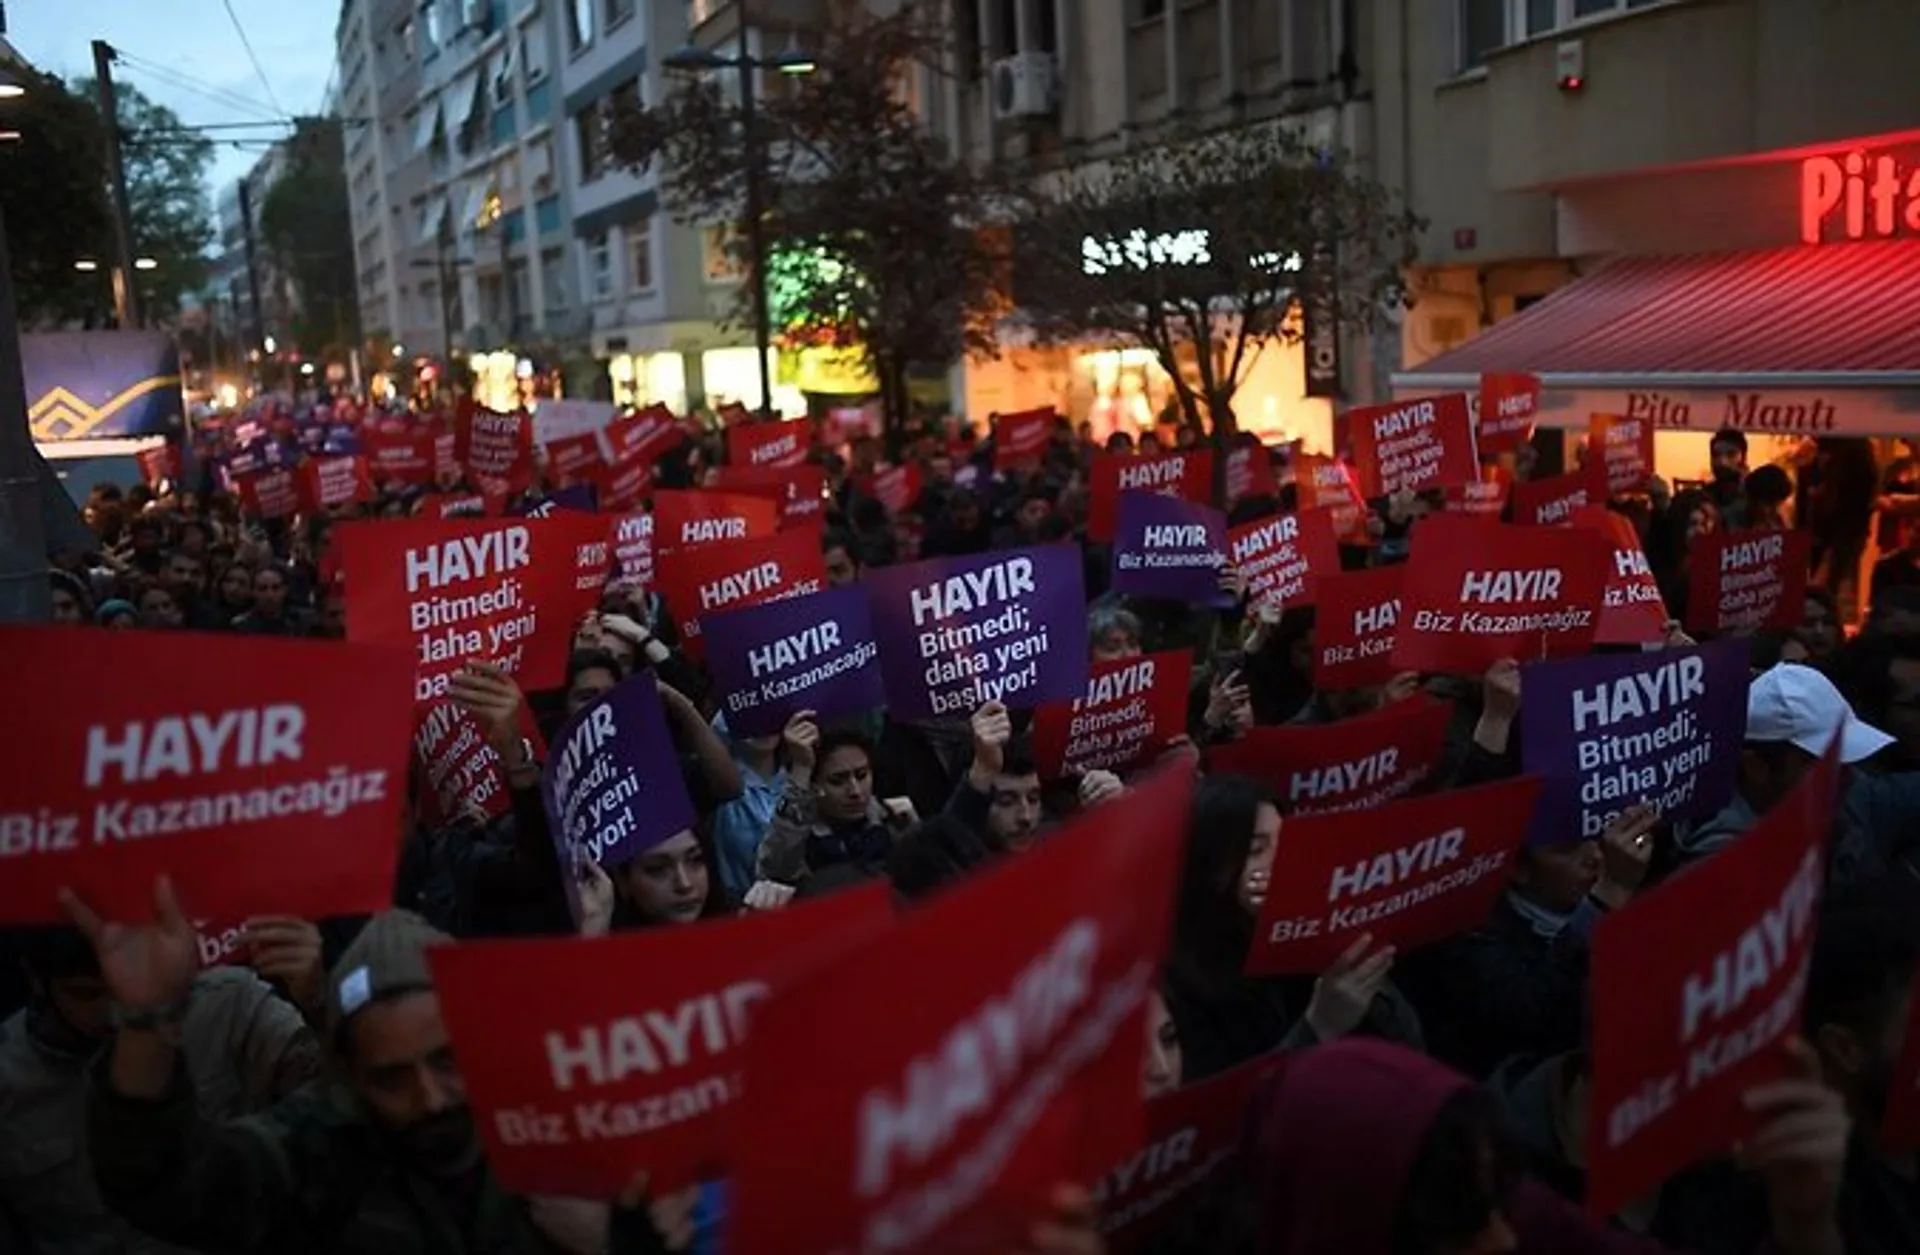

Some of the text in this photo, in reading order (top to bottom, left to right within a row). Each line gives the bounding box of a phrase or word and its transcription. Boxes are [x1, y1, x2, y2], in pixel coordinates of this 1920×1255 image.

[1374, 401, 1436, 440] HAYIR
[1723, 393, 1838, 430] Mantı
[1119, 457, 1185, 489] HAYIR
[681, 517, 747, 543] HAYIR
[1144, 524, 1207, 548] HAYIR
[1232, 515, 1299, 564] HAYIR
[1720, 535, 1782, 571] HAYIR
[405, 525, 532, 594] HAYIR
[700, 561, 782, 610] HAYIR
[1460, 568, 1562, 603] HAYIR
[411, 577, 523, 632] Bitmedi;
[910, 556, 1036, 626] HAYIR
[488, 605, 537, 654] yeni
[919, 603, 1031, 659] Bitmedi;
[1413, 605, 1592, 634] Biz Kazanacağız
[748, 620, 842, 678] HAYIR
[924, 625, 1049, 687] daha yeni
[728, 689, 760, 712] Biz
[929, 661, 1038, 715] başlıyor!
[1573, 655, 1705, 732] HAYIR
[84, 704, 306, 788] HAYIR
[1579, 709, 1698, 771] Bitmedi;
[1290, 747, 1400, 801] HAYIR
[1581, 731, 1712, 805] daha yeni
[0, 766, 388, 856] Biz Kazanacağız
[588, 765, 640, 829] yeni
[1327, 826, 1466, 903] HAYIR
[1270, 914, 1321, 944] Biz
[495, 1104, 569, 1146] Biz
